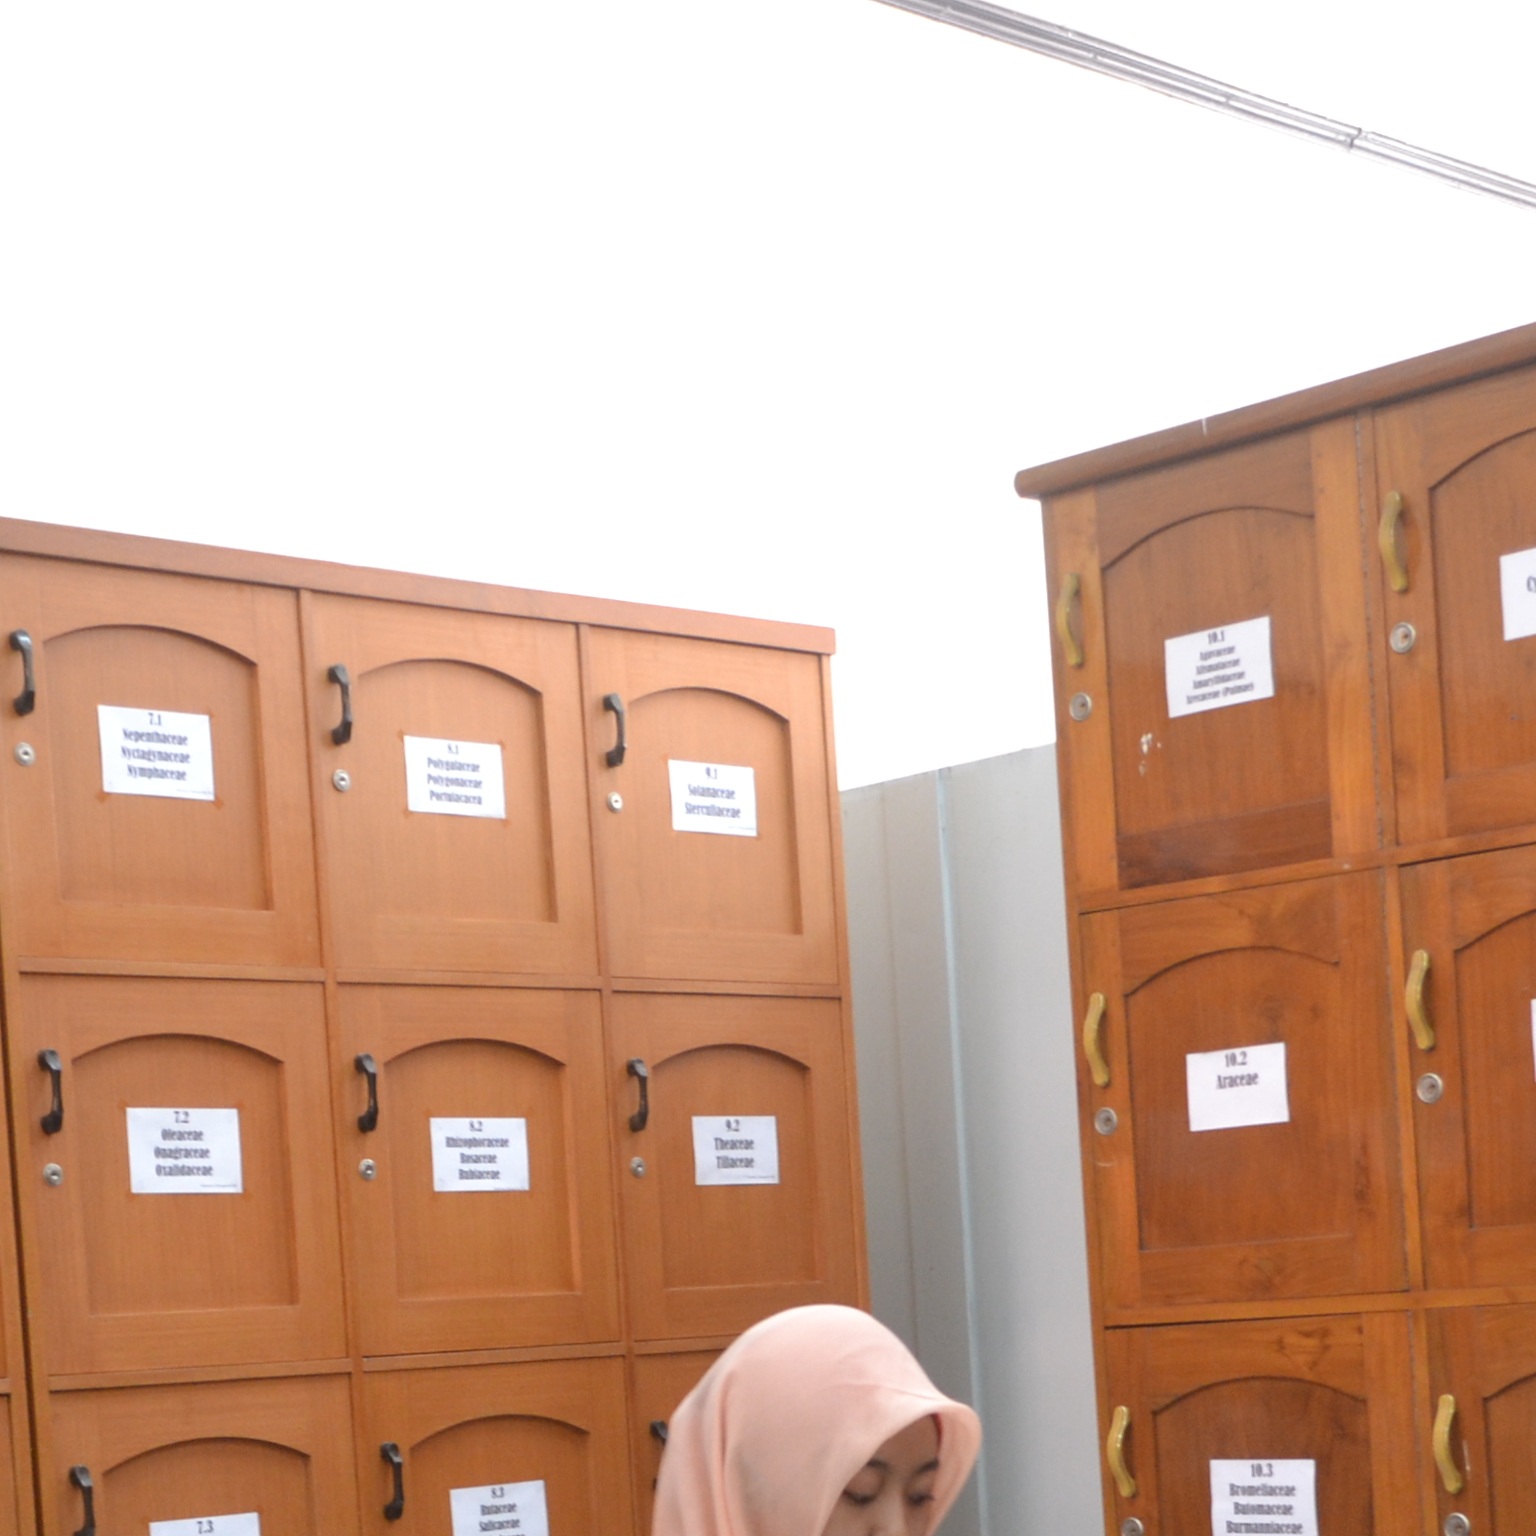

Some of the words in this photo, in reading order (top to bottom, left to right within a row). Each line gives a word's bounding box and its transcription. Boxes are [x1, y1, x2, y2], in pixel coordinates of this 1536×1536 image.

[1208, 630, 1225, 645] 10.1
[1225, 1051, 1247, 1067] 10.2
[1216, 1072, 1259, 1089] Araceae
[173, 1111, 189, 1123] 7.2
[1250, 1463, 1274, 1477] 10.3
[197, 1520, 214, 1533] 7.3
